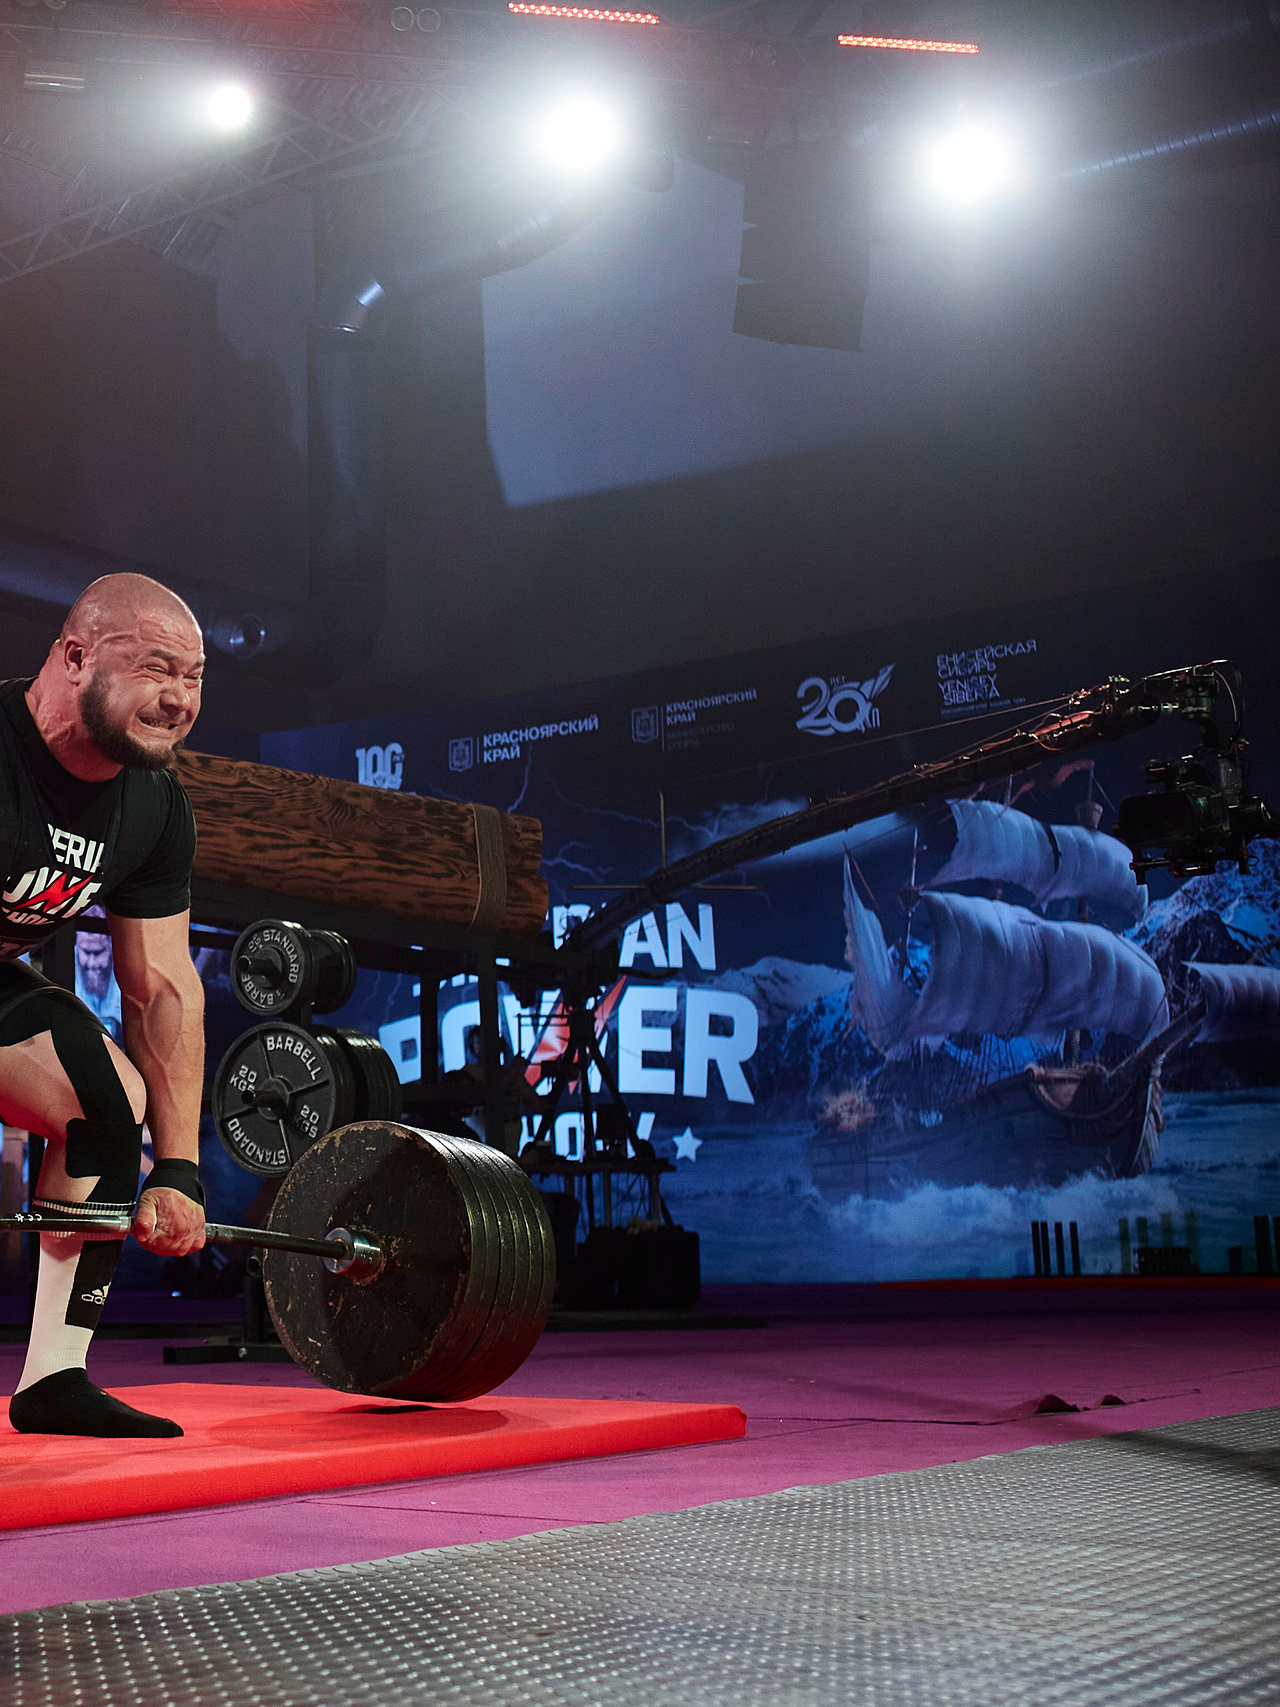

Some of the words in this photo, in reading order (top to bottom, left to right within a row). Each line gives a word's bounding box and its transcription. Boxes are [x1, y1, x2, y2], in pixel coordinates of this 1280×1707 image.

[937, 639, 1037, 667] ЕНИСЕЙСКАЯ
[666, 687, 758, 714] КРАСНОЯРСКИЙ
[483, 714, 599, 749] КРАСНОЯРСКИЙ
[666, 711, 696, 726] КРАЙ
[483, 744, 521, 764] КРАЙ
[263, 929, 300, 983] STANDARD
[266, 1036, 321, 1081] BARBELL
[239, 1064, 258, 1083] 20
[300, 1104, 320, 1124] 20
[228, 1118, 287, 1166] STANDARD
